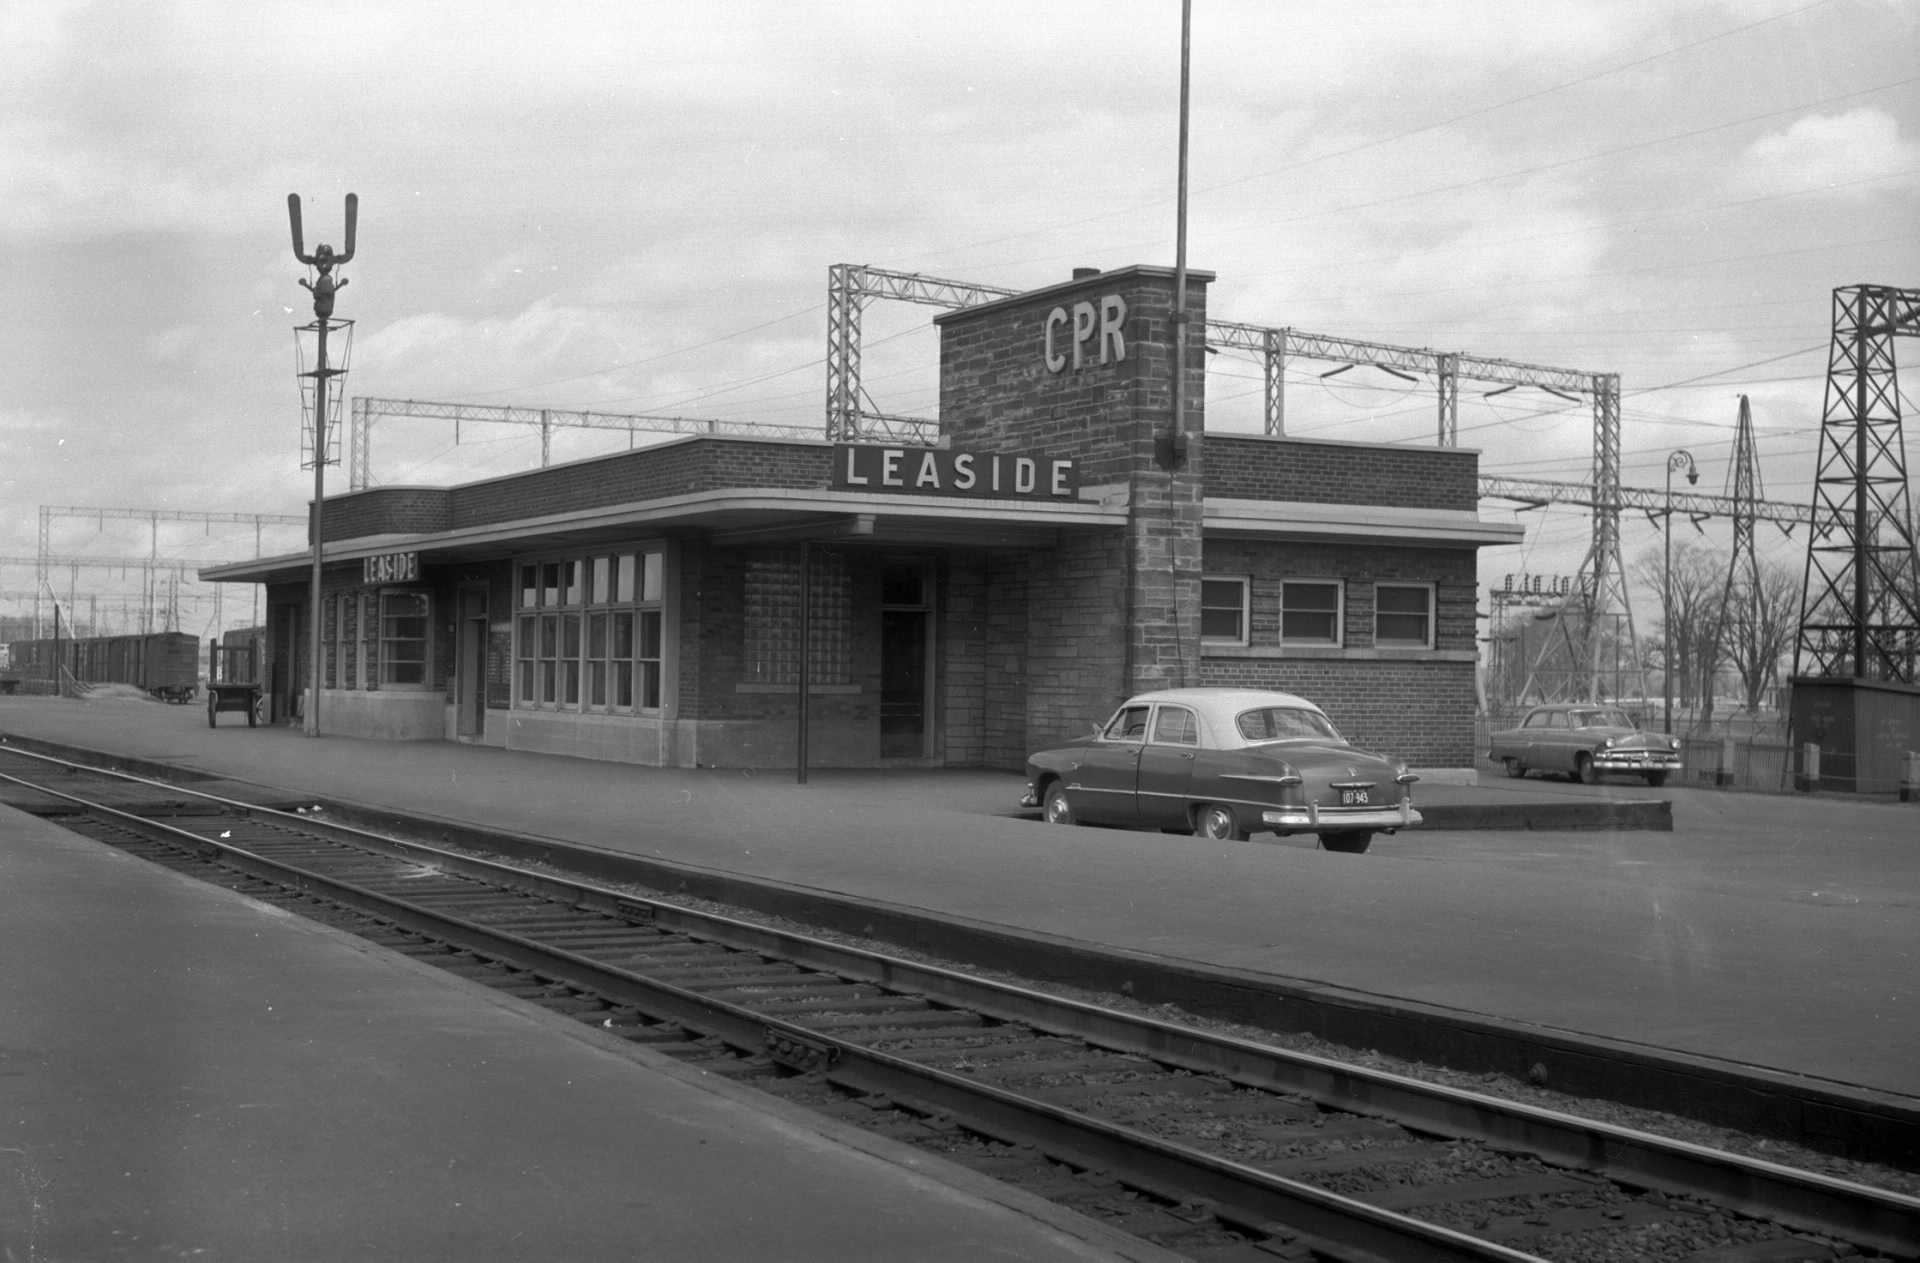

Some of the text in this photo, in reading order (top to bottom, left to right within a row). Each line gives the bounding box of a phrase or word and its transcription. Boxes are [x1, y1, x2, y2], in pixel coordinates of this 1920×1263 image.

[1045, 294, 1127, 373] CPR
[847, 447, 1072, 495] LEASIDE
[363, 552, 415, 583] LEASIDE
